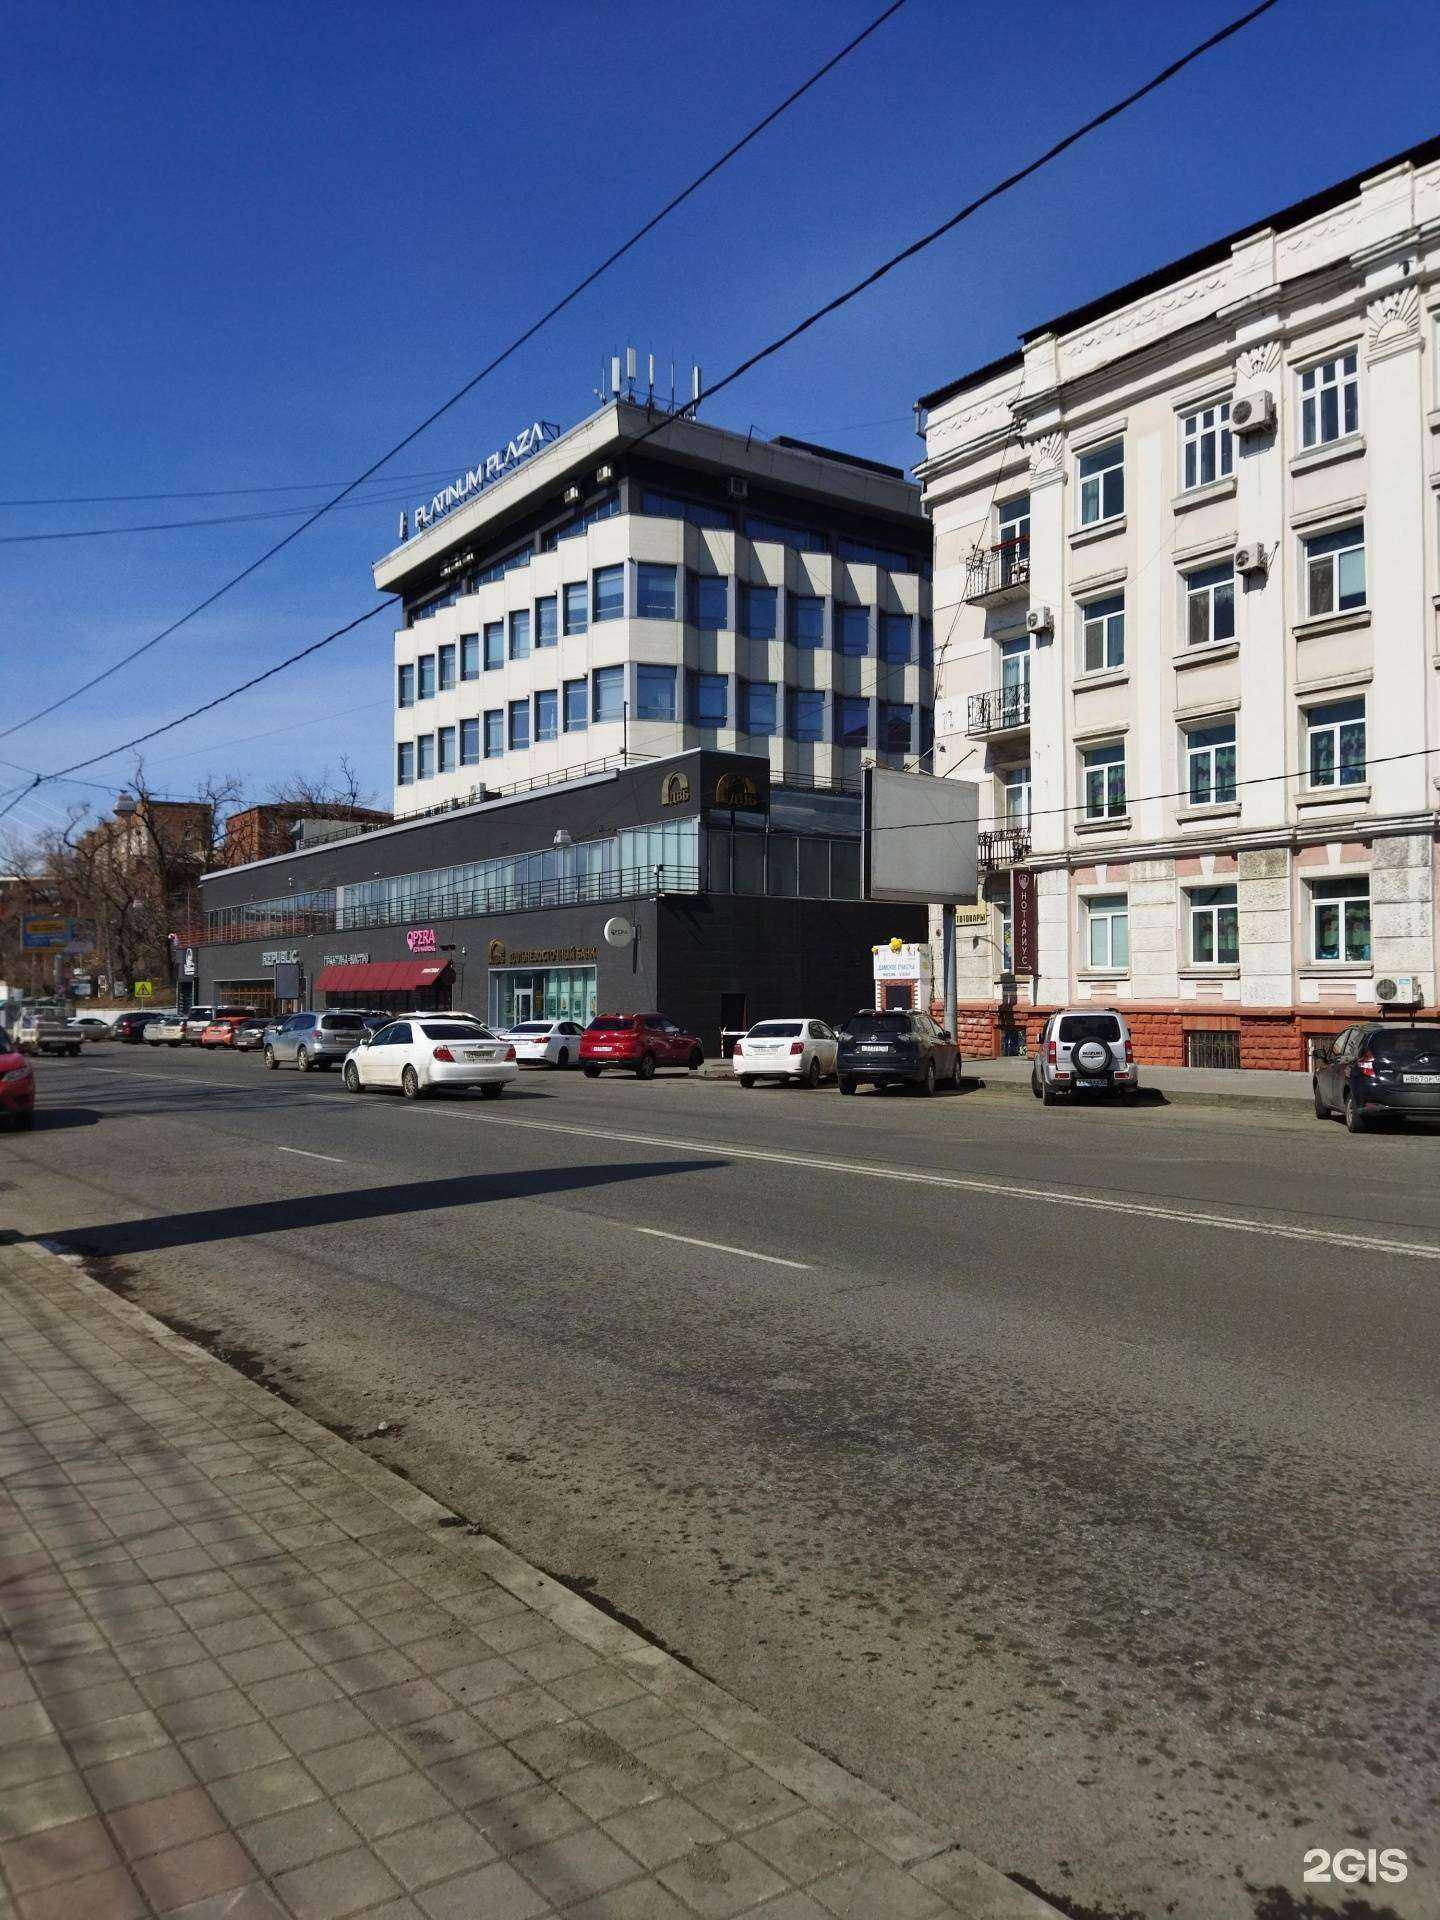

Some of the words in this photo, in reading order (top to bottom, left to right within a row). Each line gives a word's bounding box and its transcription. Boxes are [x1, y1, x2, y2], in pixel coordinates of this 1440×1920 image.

[414, 463, 482, 528] PLATINUM
[486, 422, 544, 477] PLAZA
[262, 950, 300, 966] REPUBLIC
